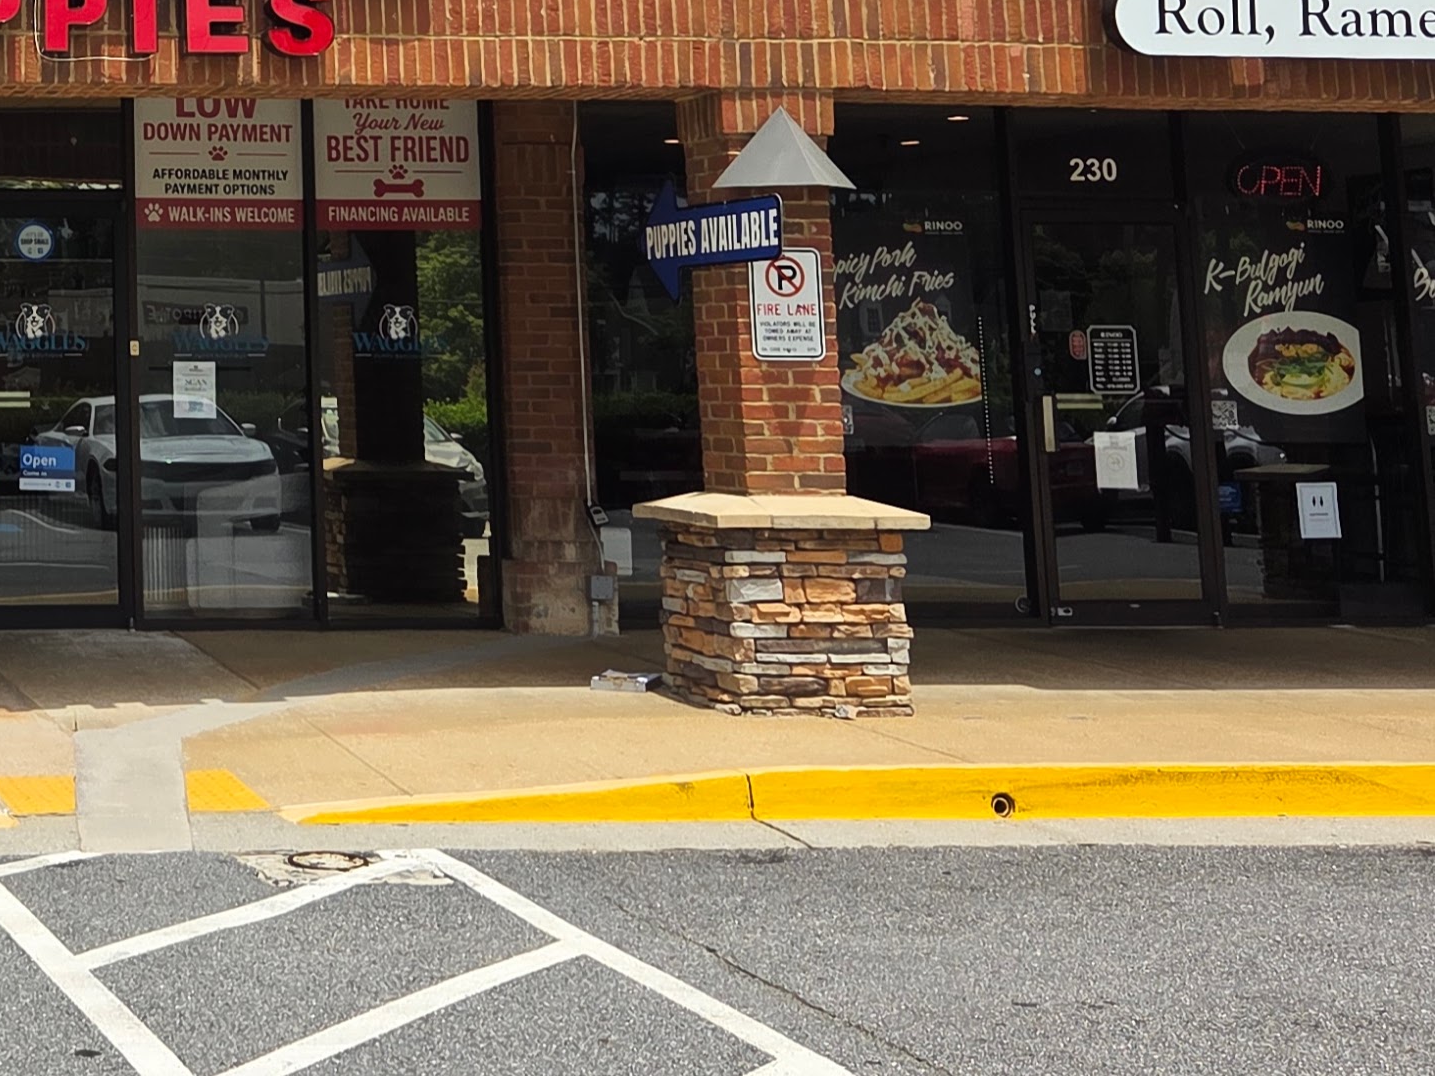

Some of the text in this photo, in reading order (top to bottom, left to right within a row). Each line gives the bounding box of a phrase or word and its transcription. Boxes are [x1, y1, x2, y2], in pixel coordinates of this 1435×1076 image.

[143, 122, 293, 143] DOWN PAYMENT
[352, 112, 445, 135] Your New
[326, 135, 469, 163] BEST FRIEND
[152, 168, 289, 181] AFFORDABLE MONTHLY
[1069, 157, 1117, 182] 230
[1237, 165, 1321, 196] OPEN
[164, 183, 275, 196] PAYMENT OPTIONS
[168, 206, 295, 223] WALK-INS WELCOME
[328, 206, 469, 222] FINANCING AVAILABLE
[1307, 219, 1344, 229] RINOO
[646, 208, 779, 260] PUPPIES AVAILABLE
[924, 221, 963, 231] RINOO
[833, 240, 917, 283] picy Pork
[1204, 242, 1305, 295] K-Bulgogi
[839, 269, 955, 310] Kimchi Fries
[1243, 274, 1324, 317] Ramyun
[757, 304, 817, 316] FIRE LANE
[22, 453, 57, 468] Open
